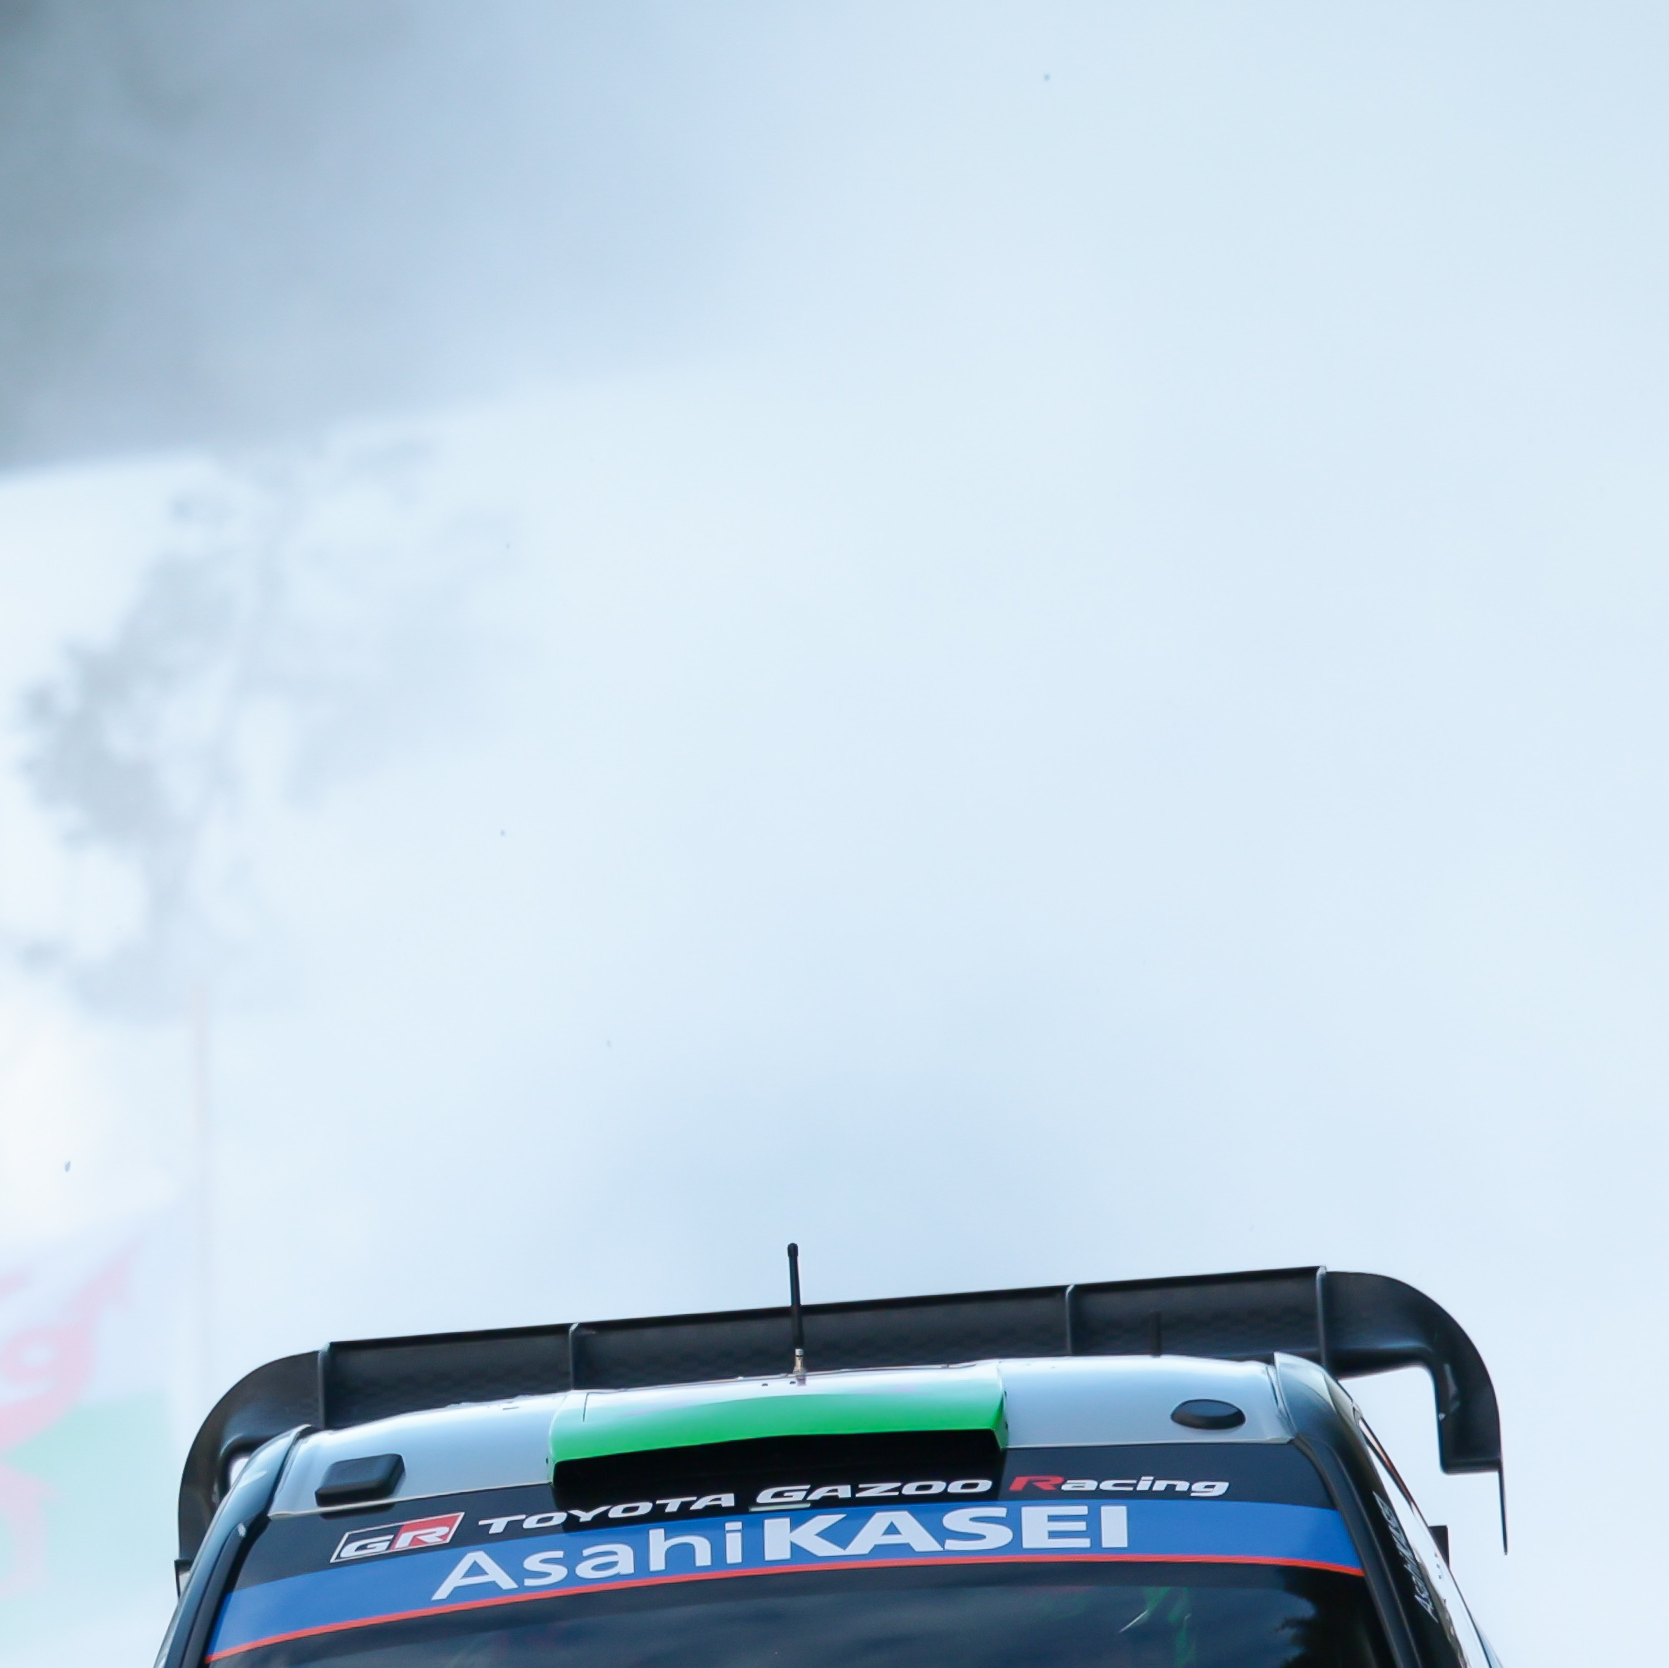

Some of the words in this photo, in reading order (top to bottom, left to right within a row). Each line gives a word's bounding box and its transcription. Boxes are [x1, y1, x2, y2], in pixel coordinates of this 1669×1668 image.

[478, 1492, 736, 1535] TOYOTA
[755, 1478, 993, 1504] GAZOO
[1009, 1474, 1231, 1498] Racing
